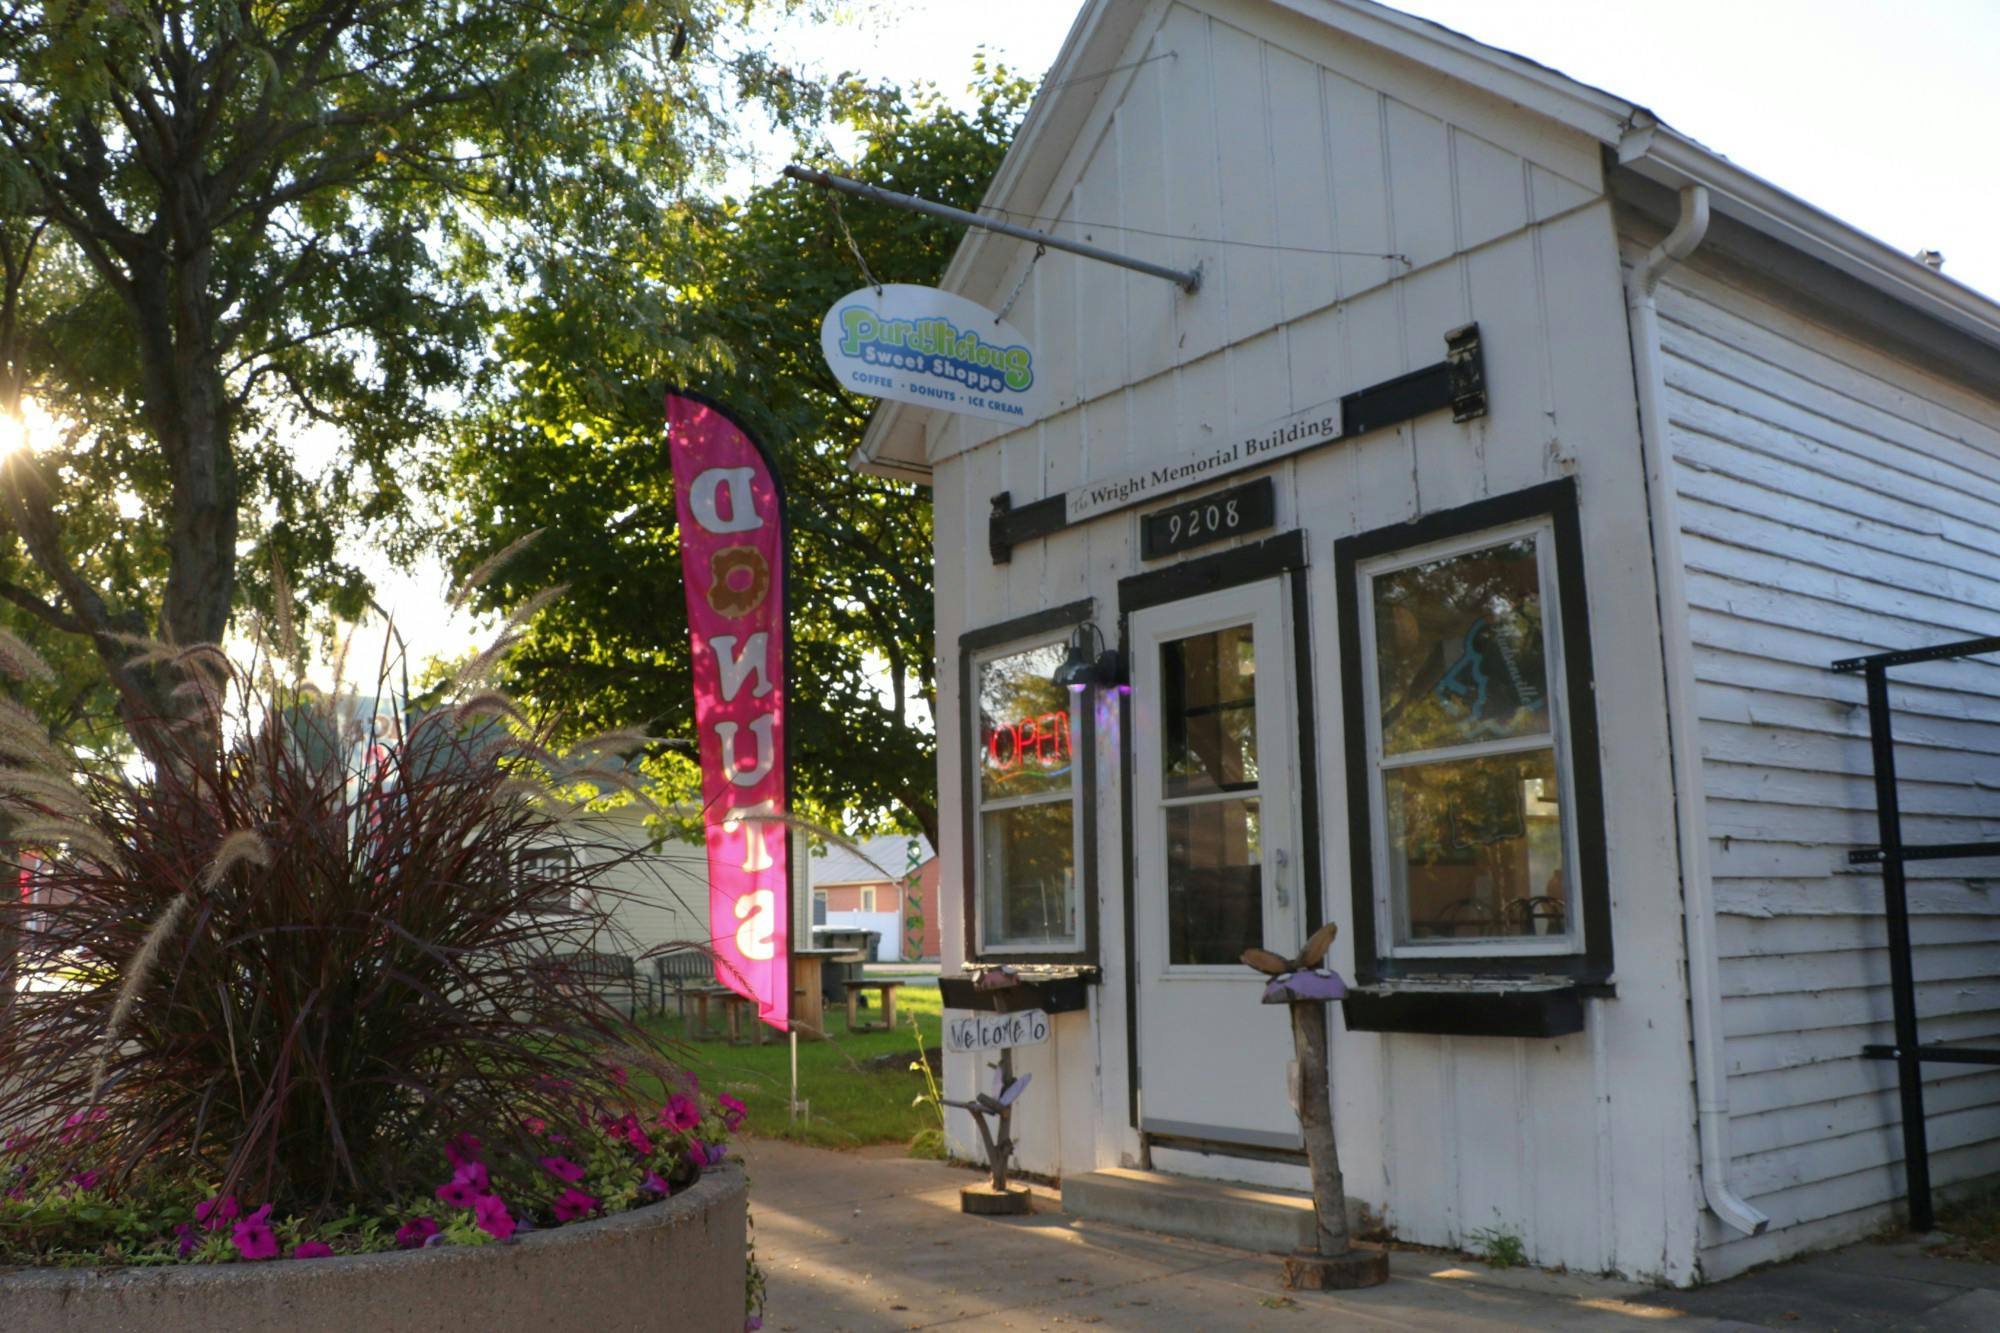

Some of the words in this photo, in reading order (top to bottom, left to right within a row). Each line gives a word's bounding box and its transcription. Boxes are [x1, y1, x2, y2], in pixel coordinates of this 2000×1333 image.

[841, 306, 1032, 390] Purdylicious
[865, 346, 925, 370] Sweet
[932, 359, 1002, 391] Shoppe
[852, 371, 893, 388] COFFEE
[910, 383, 956, 402] DONUTS
[968, 396, 985, 408] ICE
[988, 400, 1024, 416] CREAM
[1090, 470, 1146, 505] Wright
[1151, 444, 1239, 488] Memorial
[1245, 416, 1334, 456] Building
[1168, 499, 1240, 544] 9208
[990, 709, 1072, 770] OPEN
[1022, 1012, 1046, 1040] To
